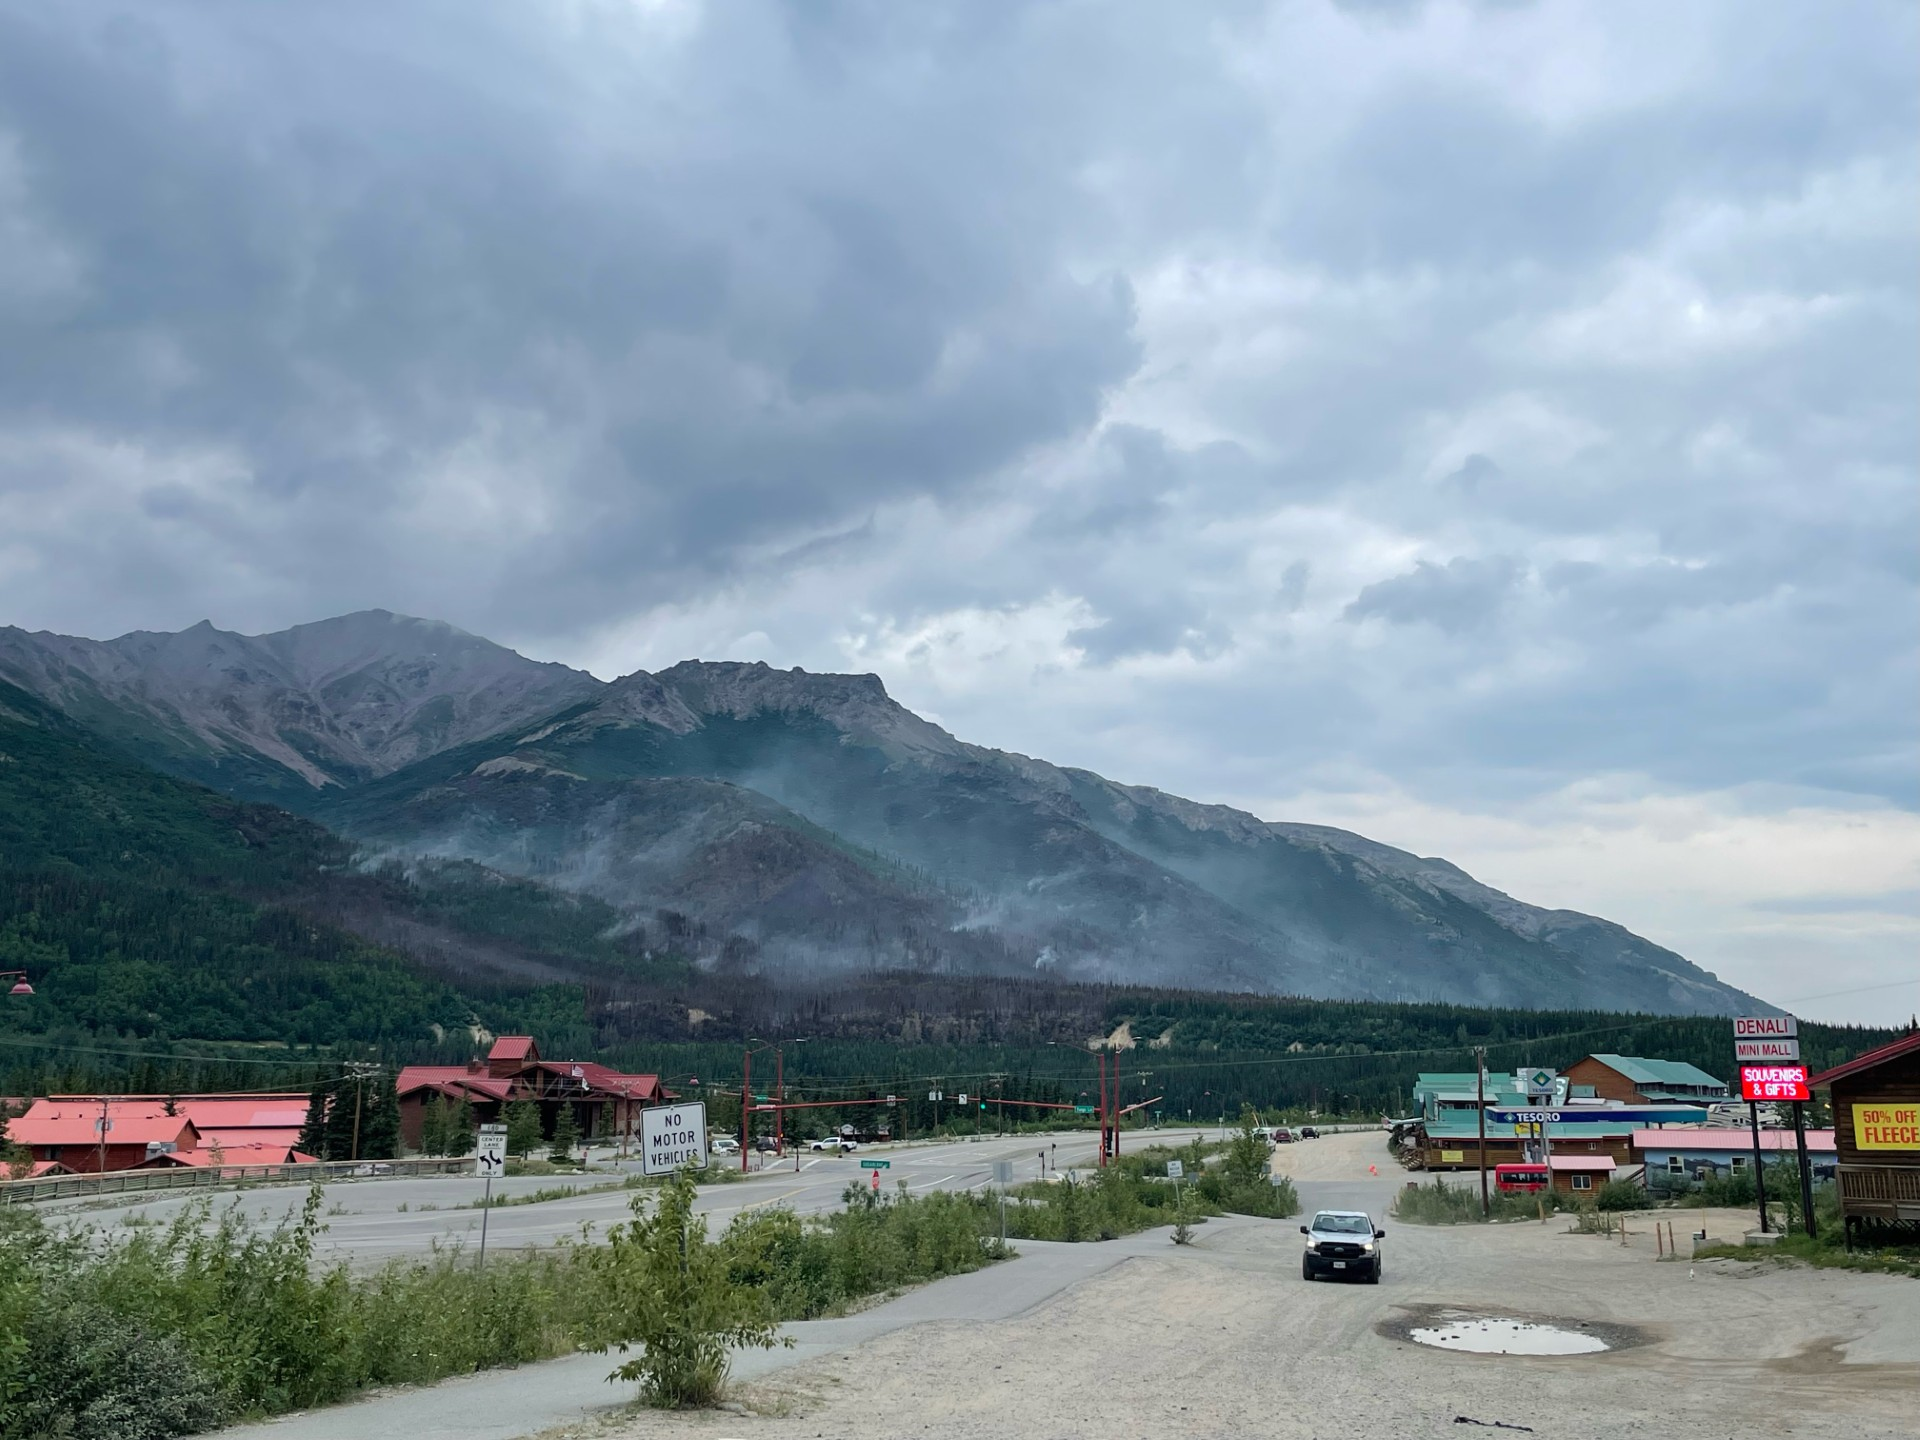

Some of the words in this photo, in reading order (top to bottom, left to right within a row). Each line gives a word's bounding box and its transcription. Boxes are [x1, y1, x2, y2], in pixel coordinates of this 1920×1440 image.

[1737, 1018, 1788, 1034] DENALI
[1738, 1044, 1760, 1056] MINI
[1762, 1043, 1791, 1056] MALL
[1744, 1068, 1804, 1082] SOUVENIRS
[1753, 1084, 1762, 1096] &
[1765, 1083, 1797, 1096] GIFTS
[665, 1113, 682, 1127] NO
[1517, 1112, 1561, 1122] TESORO
[1863, 1110, 1891, 1124] 50%
[1895, 1110, 1917, 1123] OFF
[653, 1130, 695, 1148] MOTOR
[1864, 1126, 1920, 1144] FLEECE
